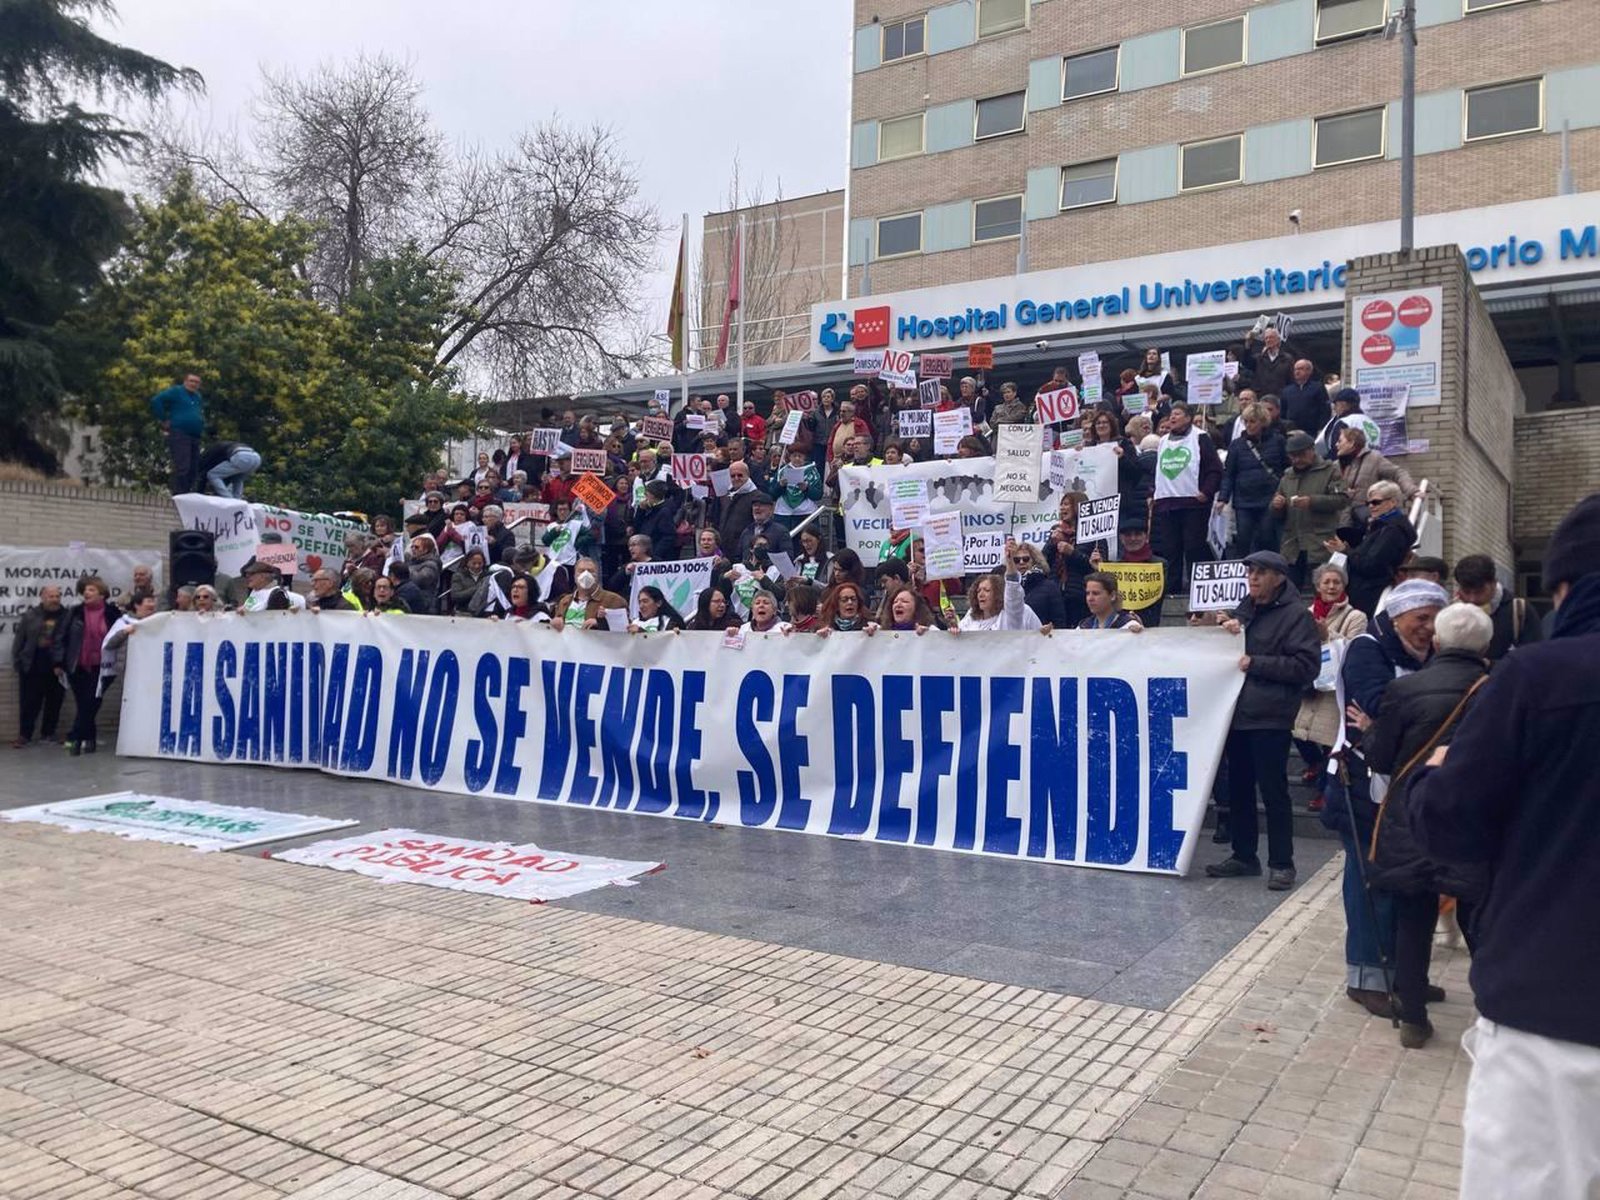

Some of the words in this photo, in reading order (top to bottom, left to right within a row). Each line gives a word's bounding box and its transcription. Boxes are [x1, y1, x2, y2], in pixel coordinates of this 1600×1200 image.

[898, 304, 1007, 341] Hospital
[1015, 287, 1129, 325] General
[1467, 236, 1543, 272] orio
[882, 350, 910, 373] NO
[784, 393, 813, 413] NO
[1037, 389, 1077, 423] NO
[672, 455, 705, 479] NO
[574, 483, 586, 493] LO
[1080, 503, 1091, 516] SE
[1092, 498, 1119, 513] VENDE
[265, 516, 291, 532] NO
[298, 525, 314, 536] SE
[1011, 514, 1027, 524] DE
[1081, 521, 1090, 537] TU
[292, 537, 350, 557] DEFIEN
[859, 541, 880, 549] POR
[991, 535, 1001, 547] la
[5, 568, 98, 579] MORATALAZ
[637, 563, 681, 576] SANIDAD
[683, 562, 709, 573] 100%
[1124, 572, 1137, 581] nos
[1138, 570, 1160, 582] cierra
[1196, 565, 1210, 579] SE
[1213, 562, 1249, 577] VEND
[1128, 589, 1137, 601] de
[1196, 585, 1209, 602] TU
[159, 641, 205, 757] LA
[212, 640, 383, 772] SANIDAD
[387, 648, 460, 786] NO
[464, 651, 530, 796] SE
[536, 660, 720, 822] VENDE,
[736, 669, 811, 829] SE
[827, 673, 1188, 871] DEFIENDE
